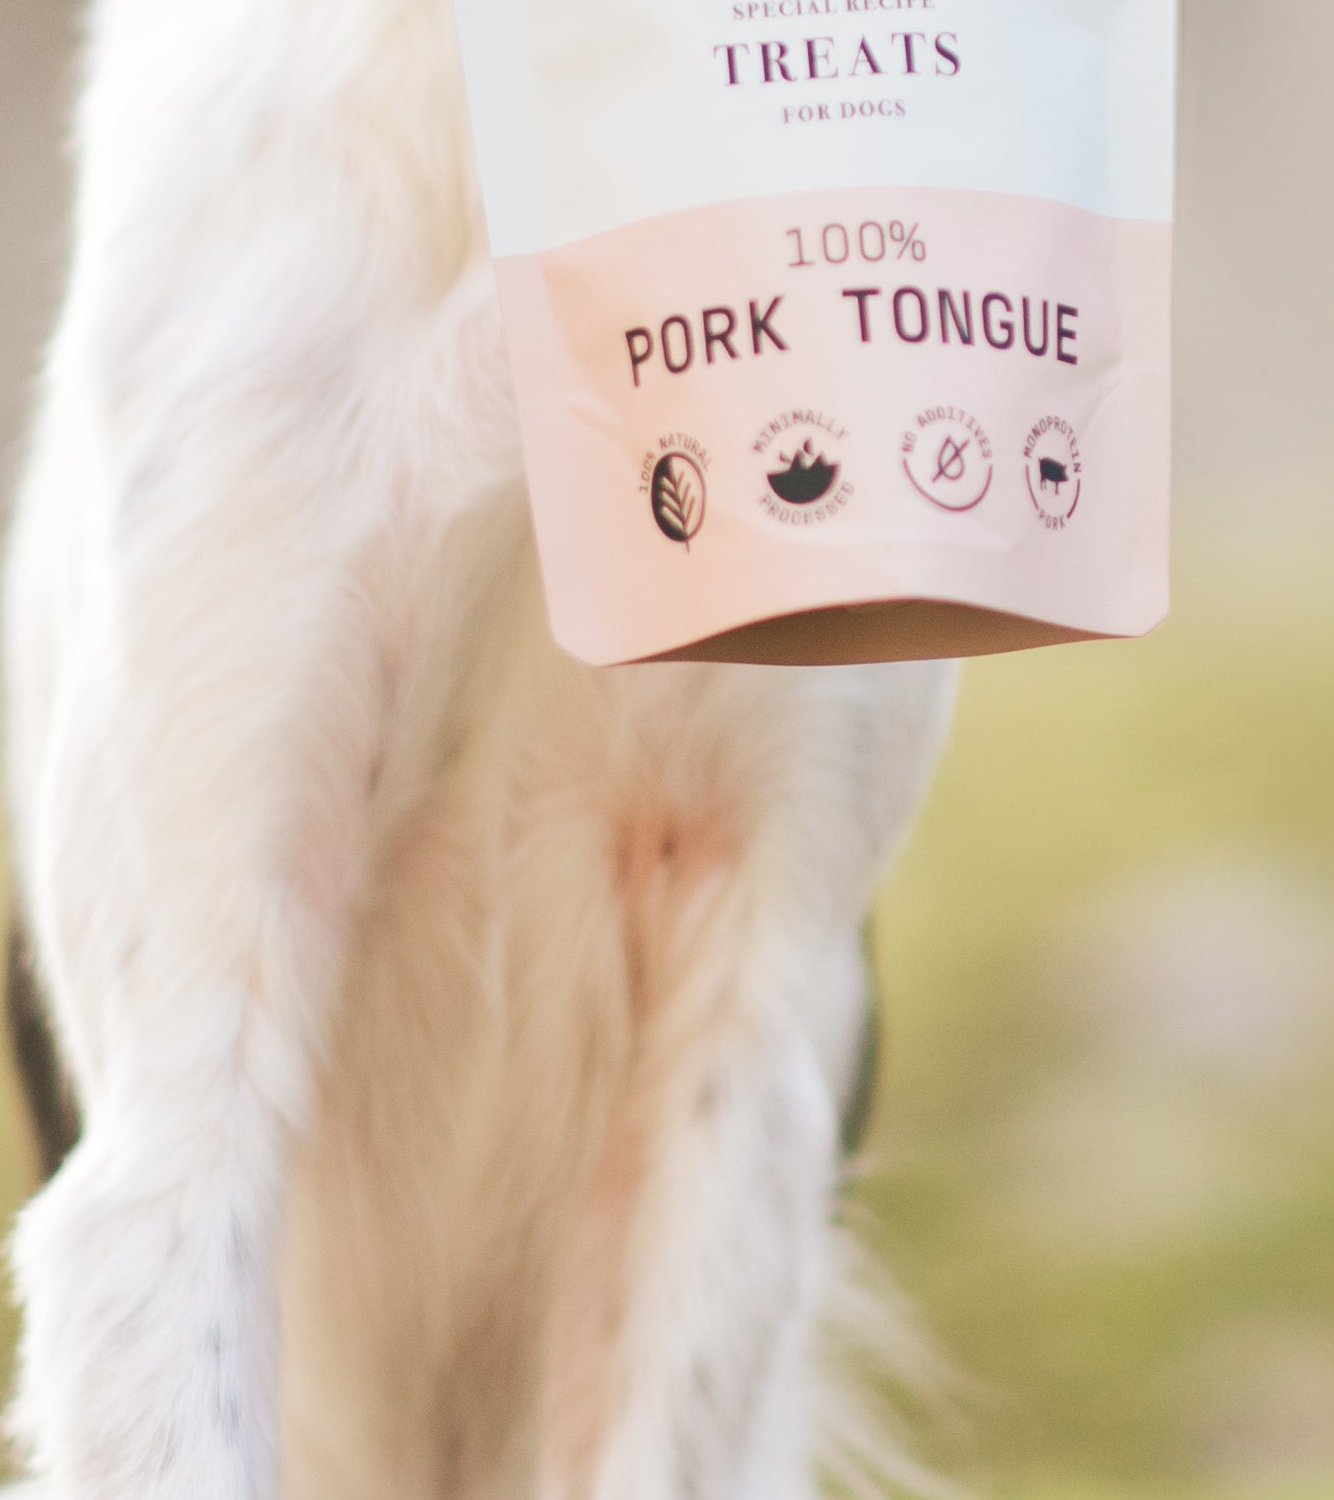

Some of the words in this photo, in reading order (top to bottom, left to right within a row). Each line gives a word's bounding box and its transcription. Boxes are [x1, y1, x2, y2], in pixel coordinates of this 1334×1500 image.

[713, 31, 962, 87] TREATS
[781, 104, 831, 124] FOR
[840, 98, 906, 120] DOGS
[784, 218, 927, 268] 100%
[625, 295, 790, 388] PORK
[842, 285, 1079, 366] TONGUE
[658, 432, 713, 472] NATURAL
[753, 408, 848, 453] MINIMALLY
[901, 431, 917, 453] NO
[917, 406, 993, 459] ADDITIVES
[1023, 415, 1082, 473] MONOPROTEIN
[759, 481, 855, 525] PROCESSED
[1038, 508, 1065, 530] PORK
